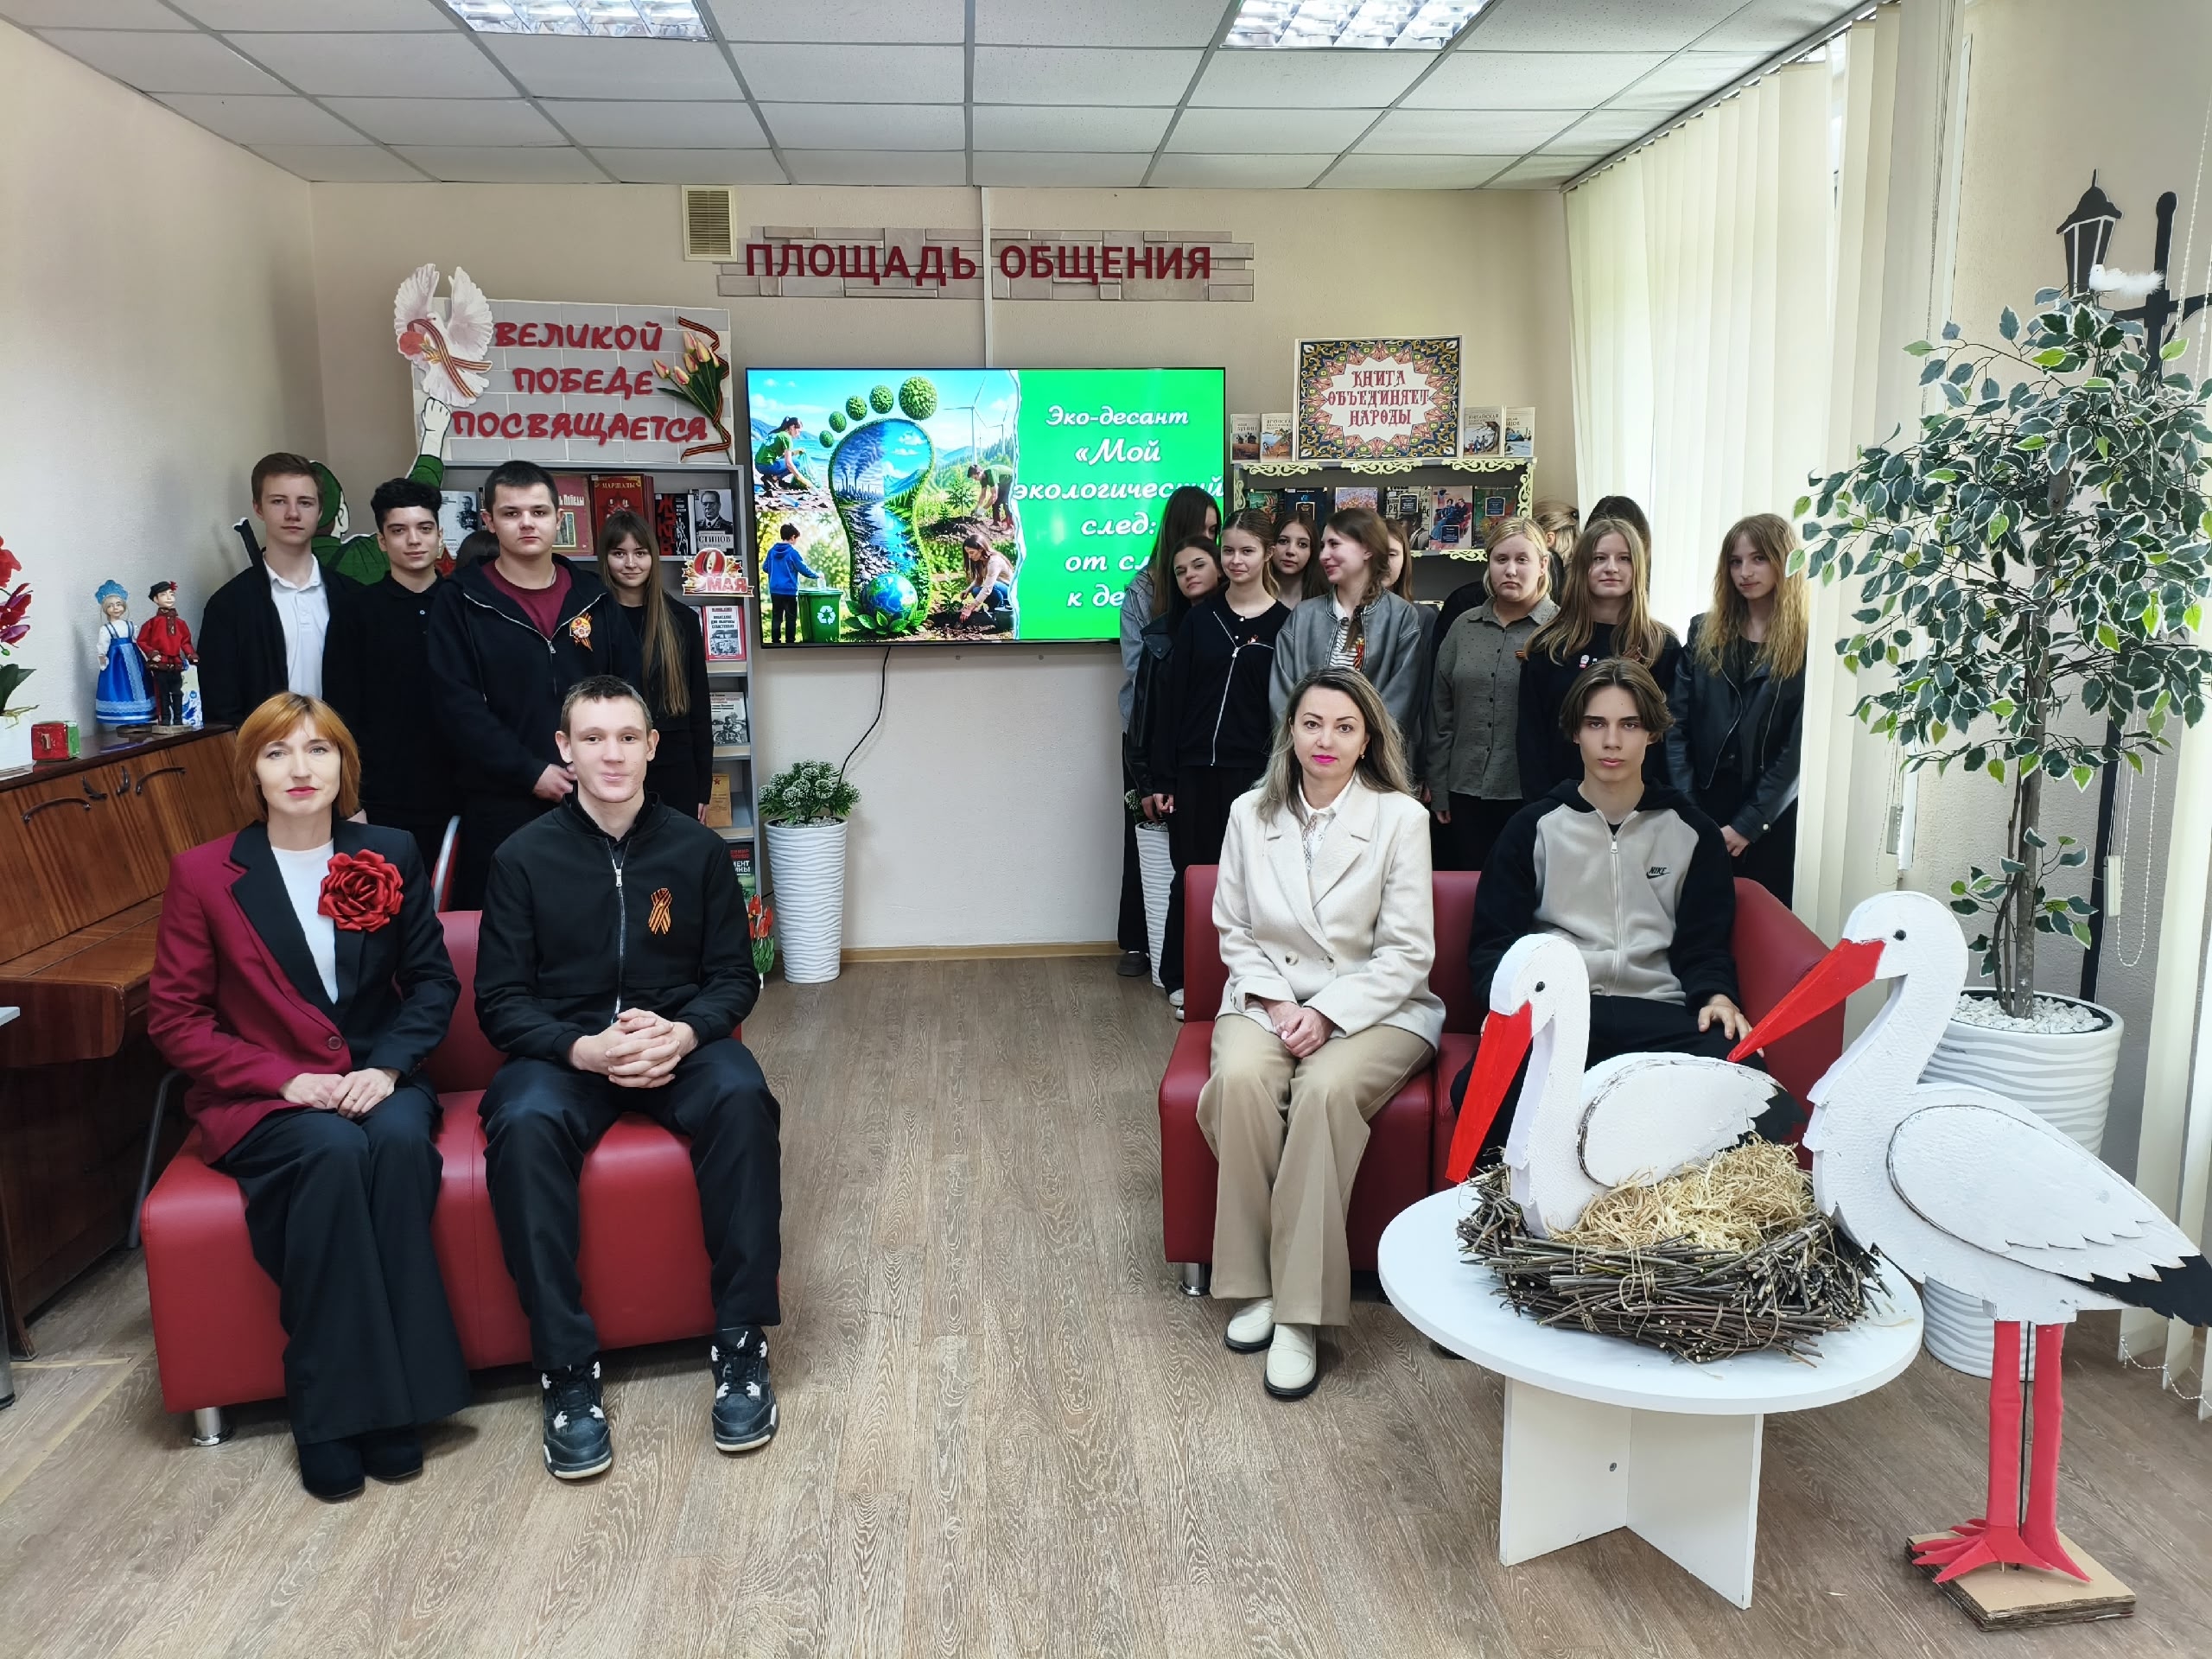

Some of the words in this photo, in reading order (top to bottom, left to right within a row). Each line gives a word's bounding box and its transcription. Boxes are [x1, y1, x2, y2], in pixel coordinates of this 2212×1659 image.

[746, 243, 976, 286] ПЛОЩАДЬ
[1000, 245, 1211, 285] ОБЩЕНИЯ
[493, 321, 664, 352] ВЕЛИКОЙ
[512, 366, 654, 400] ПОБЕДЕ
[1351, 370, 1406, 388] КНИГА
[1327, 389, 1430, 408] ОБЪЕДИНЯЕТ
[1046, 404, 1189, 427] Эко-десант
[1348, 409, 1412, 427] НАРОДЫ
[451, 410, 709, 446] ПОСВЯЩАЕТСЯ
[1074, 438, 1161, 466] «Мой
[1012, 475, 1224, 500] экологичесй
[1080, 511, 1157, 535] след:
[1065, 556, 1108, 571] от
[707, 577, 747, 593] МАЯ
[1066, 591, 1083, 607] к
[1649, 866, 1667, 875] NIKE
